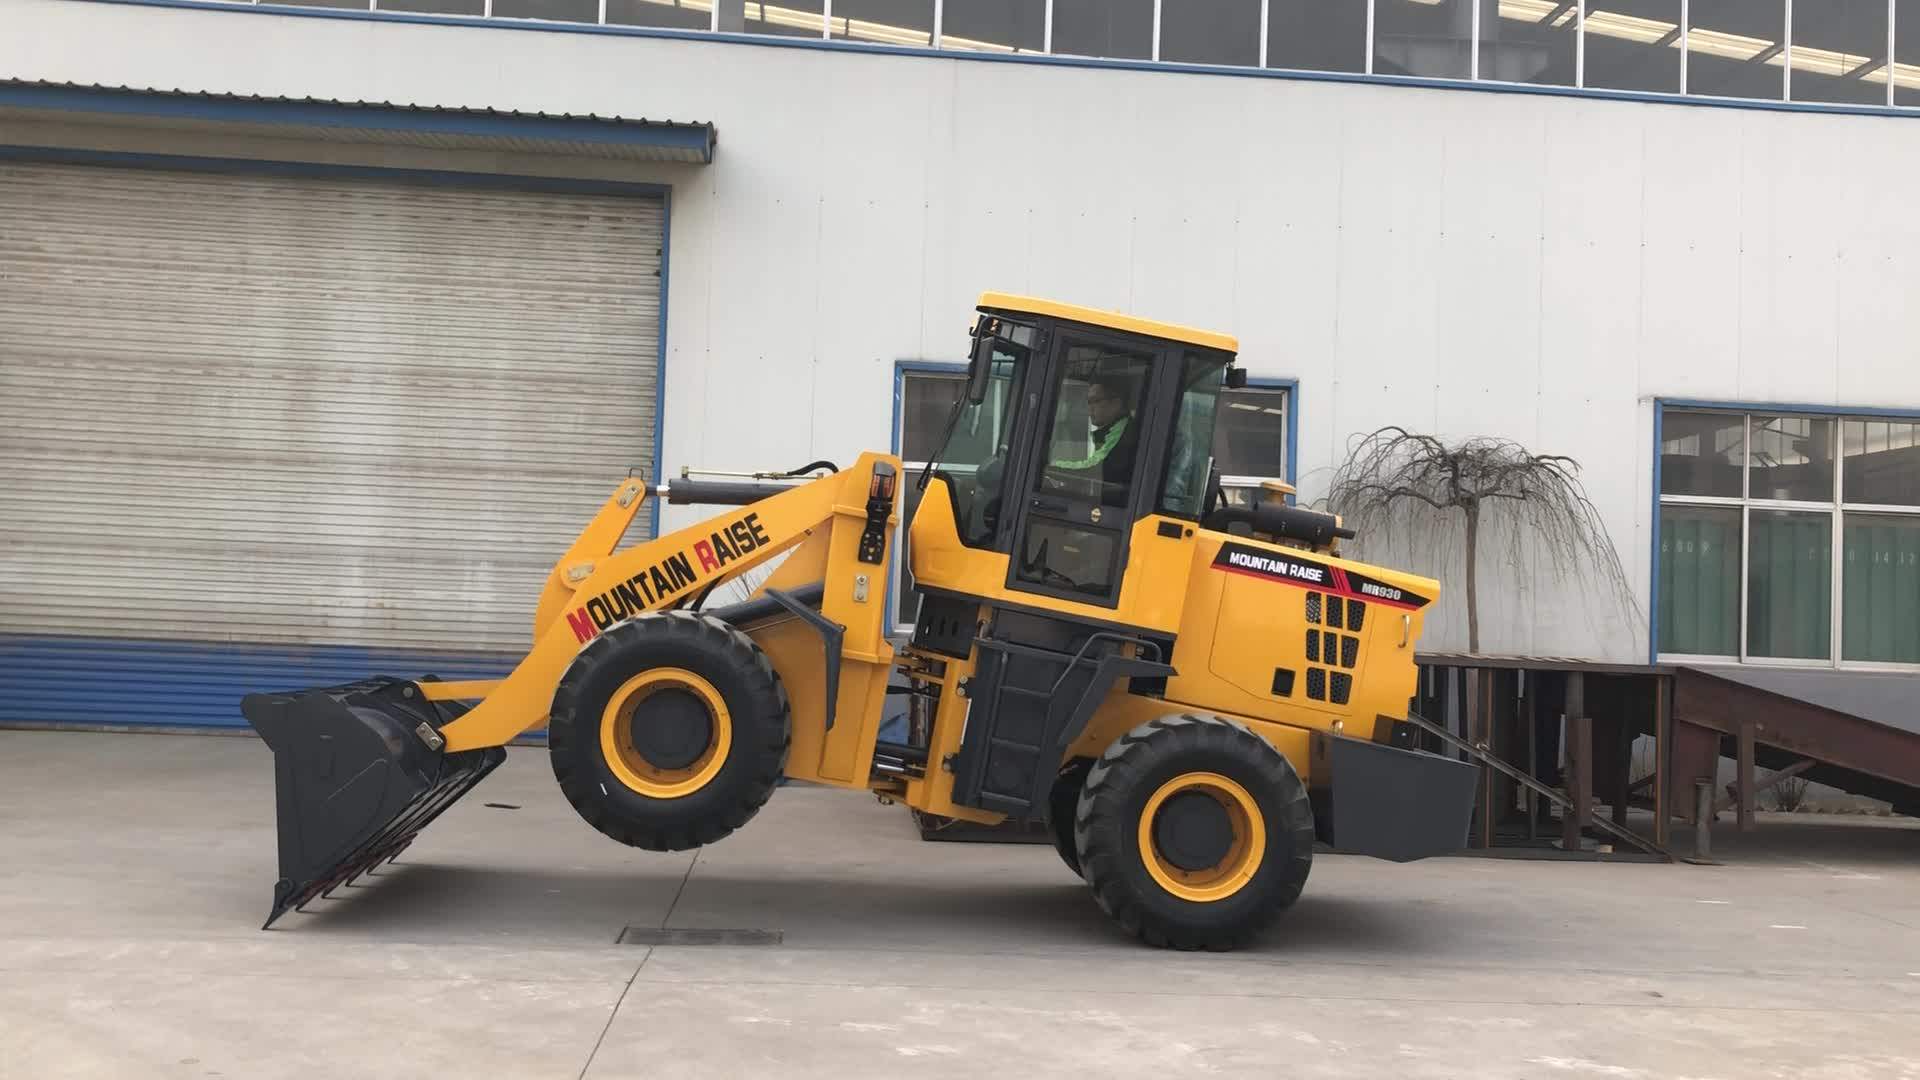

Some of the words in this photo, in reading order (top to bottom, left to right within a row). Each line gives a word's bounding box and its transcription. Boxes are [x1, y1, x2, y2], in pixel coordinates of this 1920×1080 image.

[566, 551, 697, 644] MOUNTAIN
[693, 512, 771, 574] RAISE
[1229, 551, 1287, 574] MOUNTAIN
[1289, 563, 1323, 582] RAISE
[1361, 582, 1401, 601] MR930
